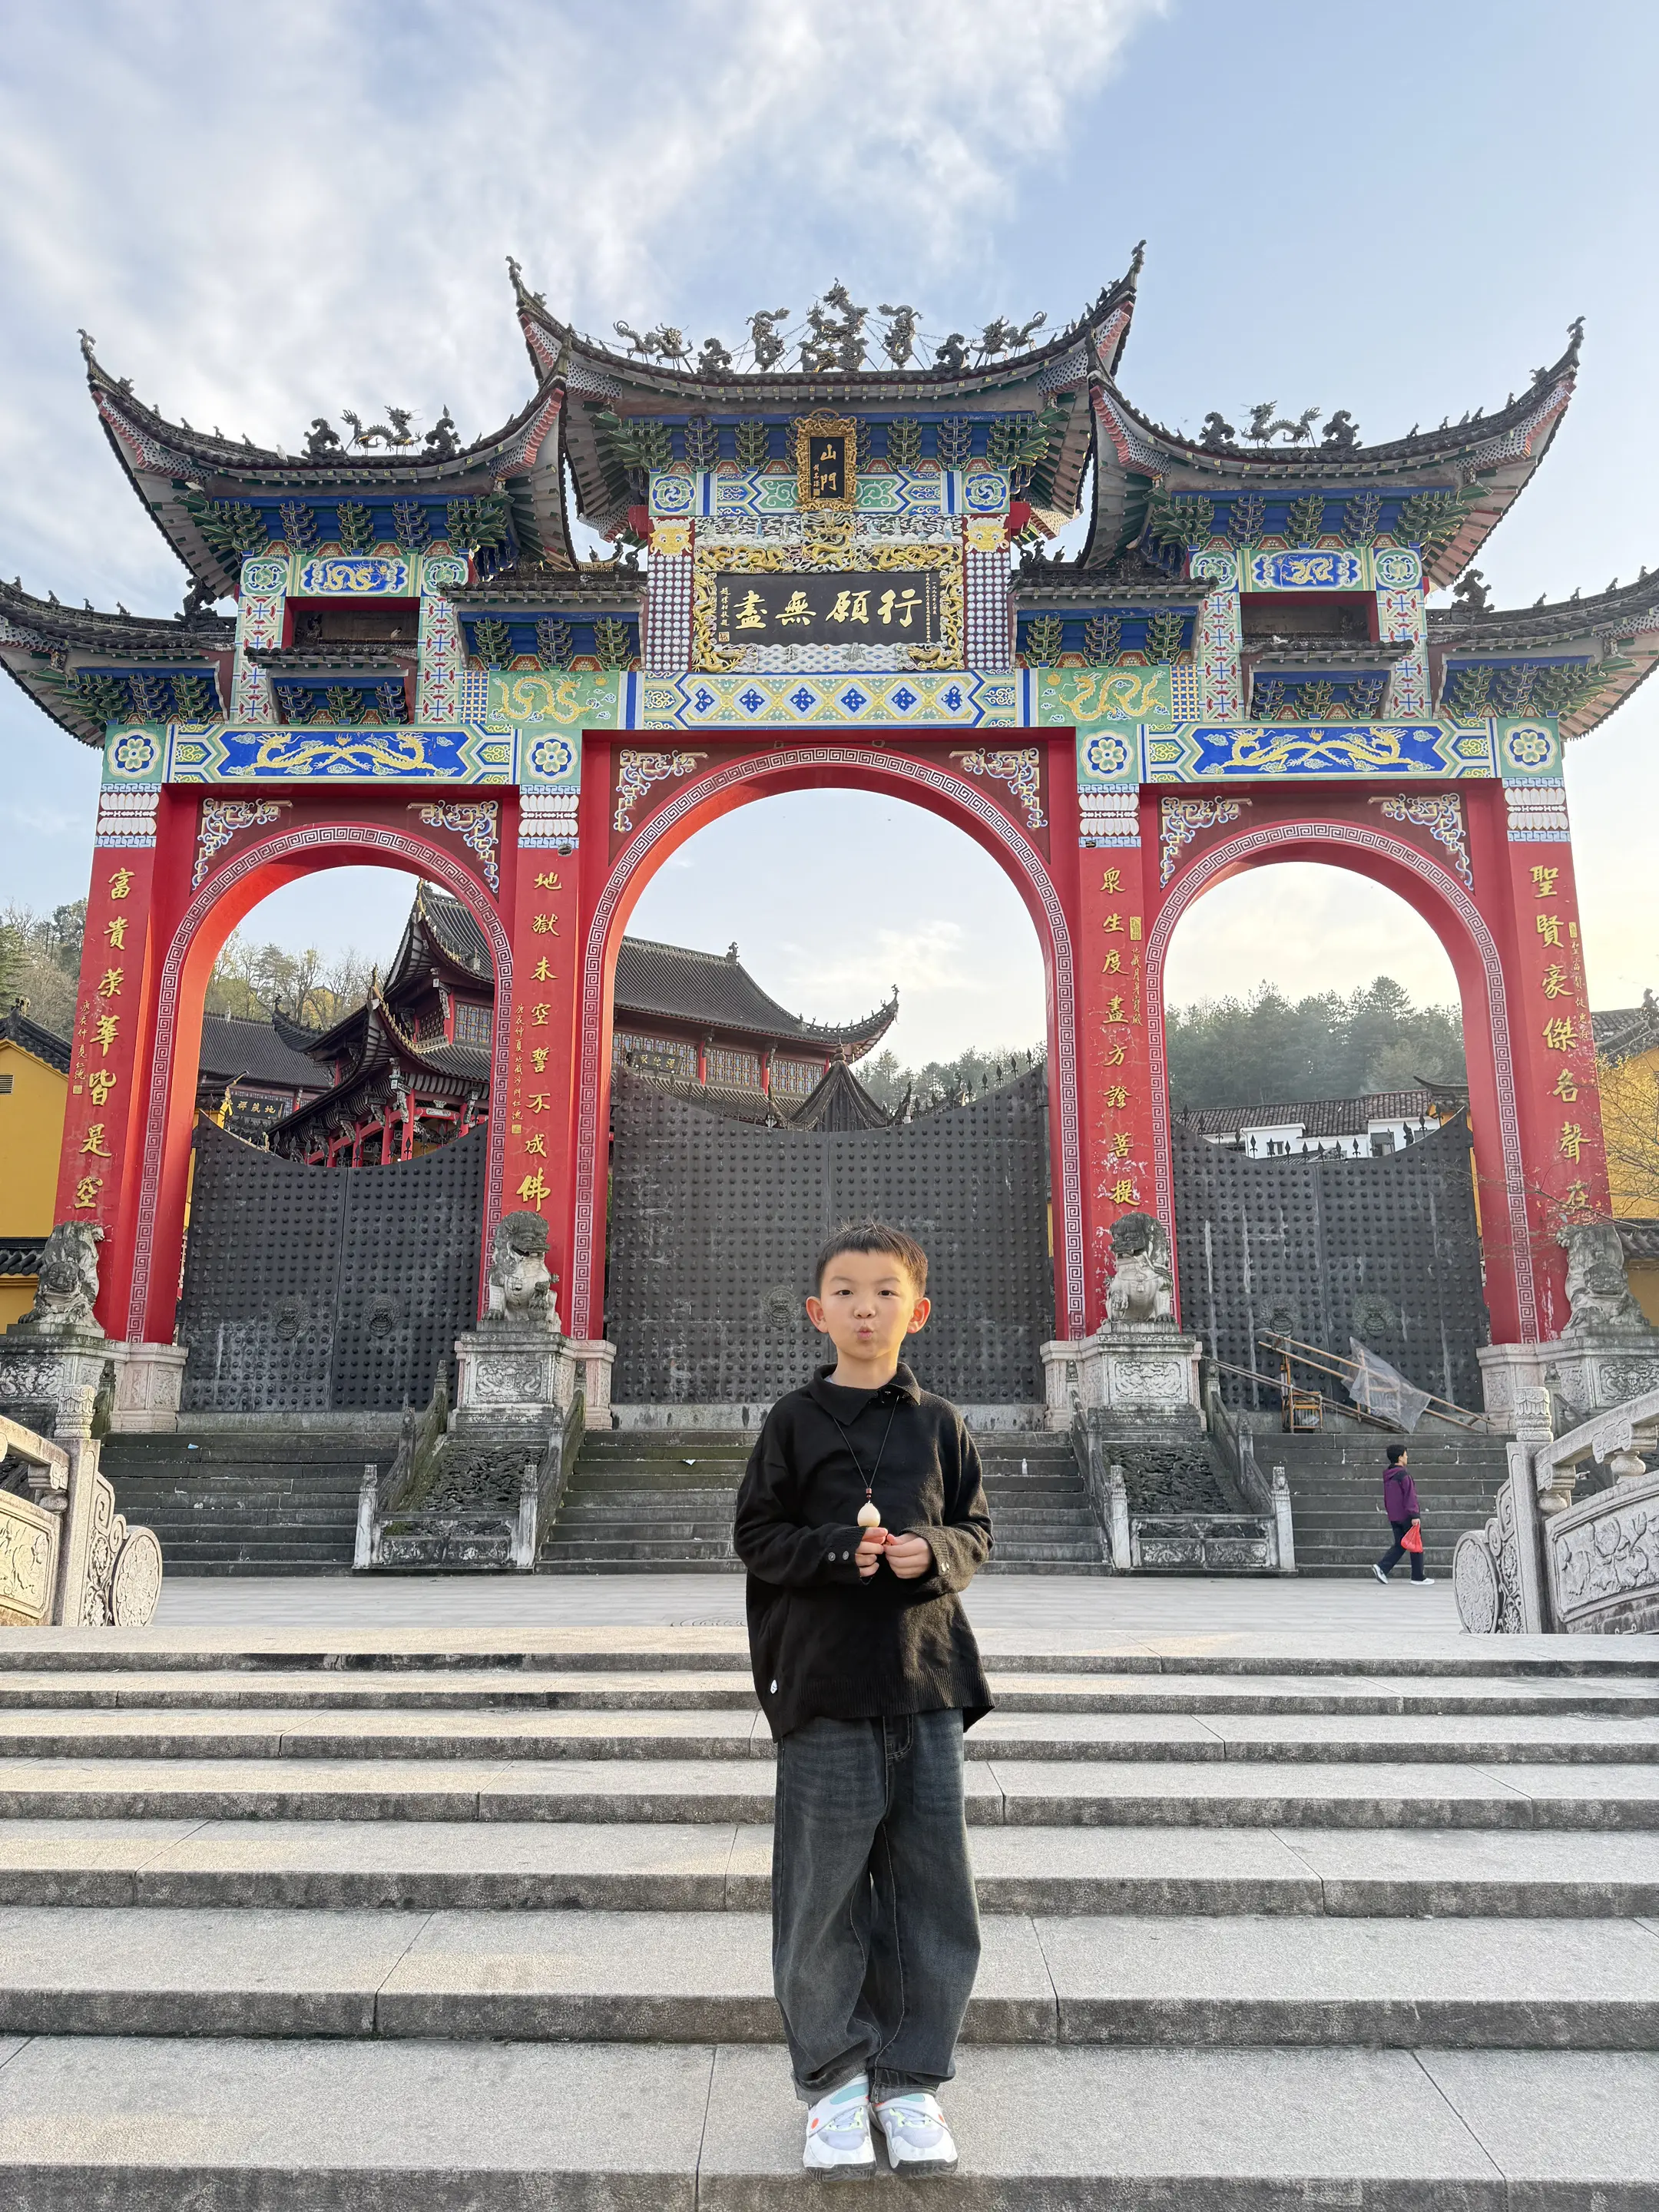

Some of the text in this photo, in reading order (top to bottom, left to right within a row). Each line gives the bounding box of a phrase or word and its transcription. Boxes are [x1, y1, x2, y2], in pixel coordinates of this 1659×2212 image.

[820, 443, 836, 492] 山門
[515, 872, 561, 1212] 地獄未空誓不成佛
